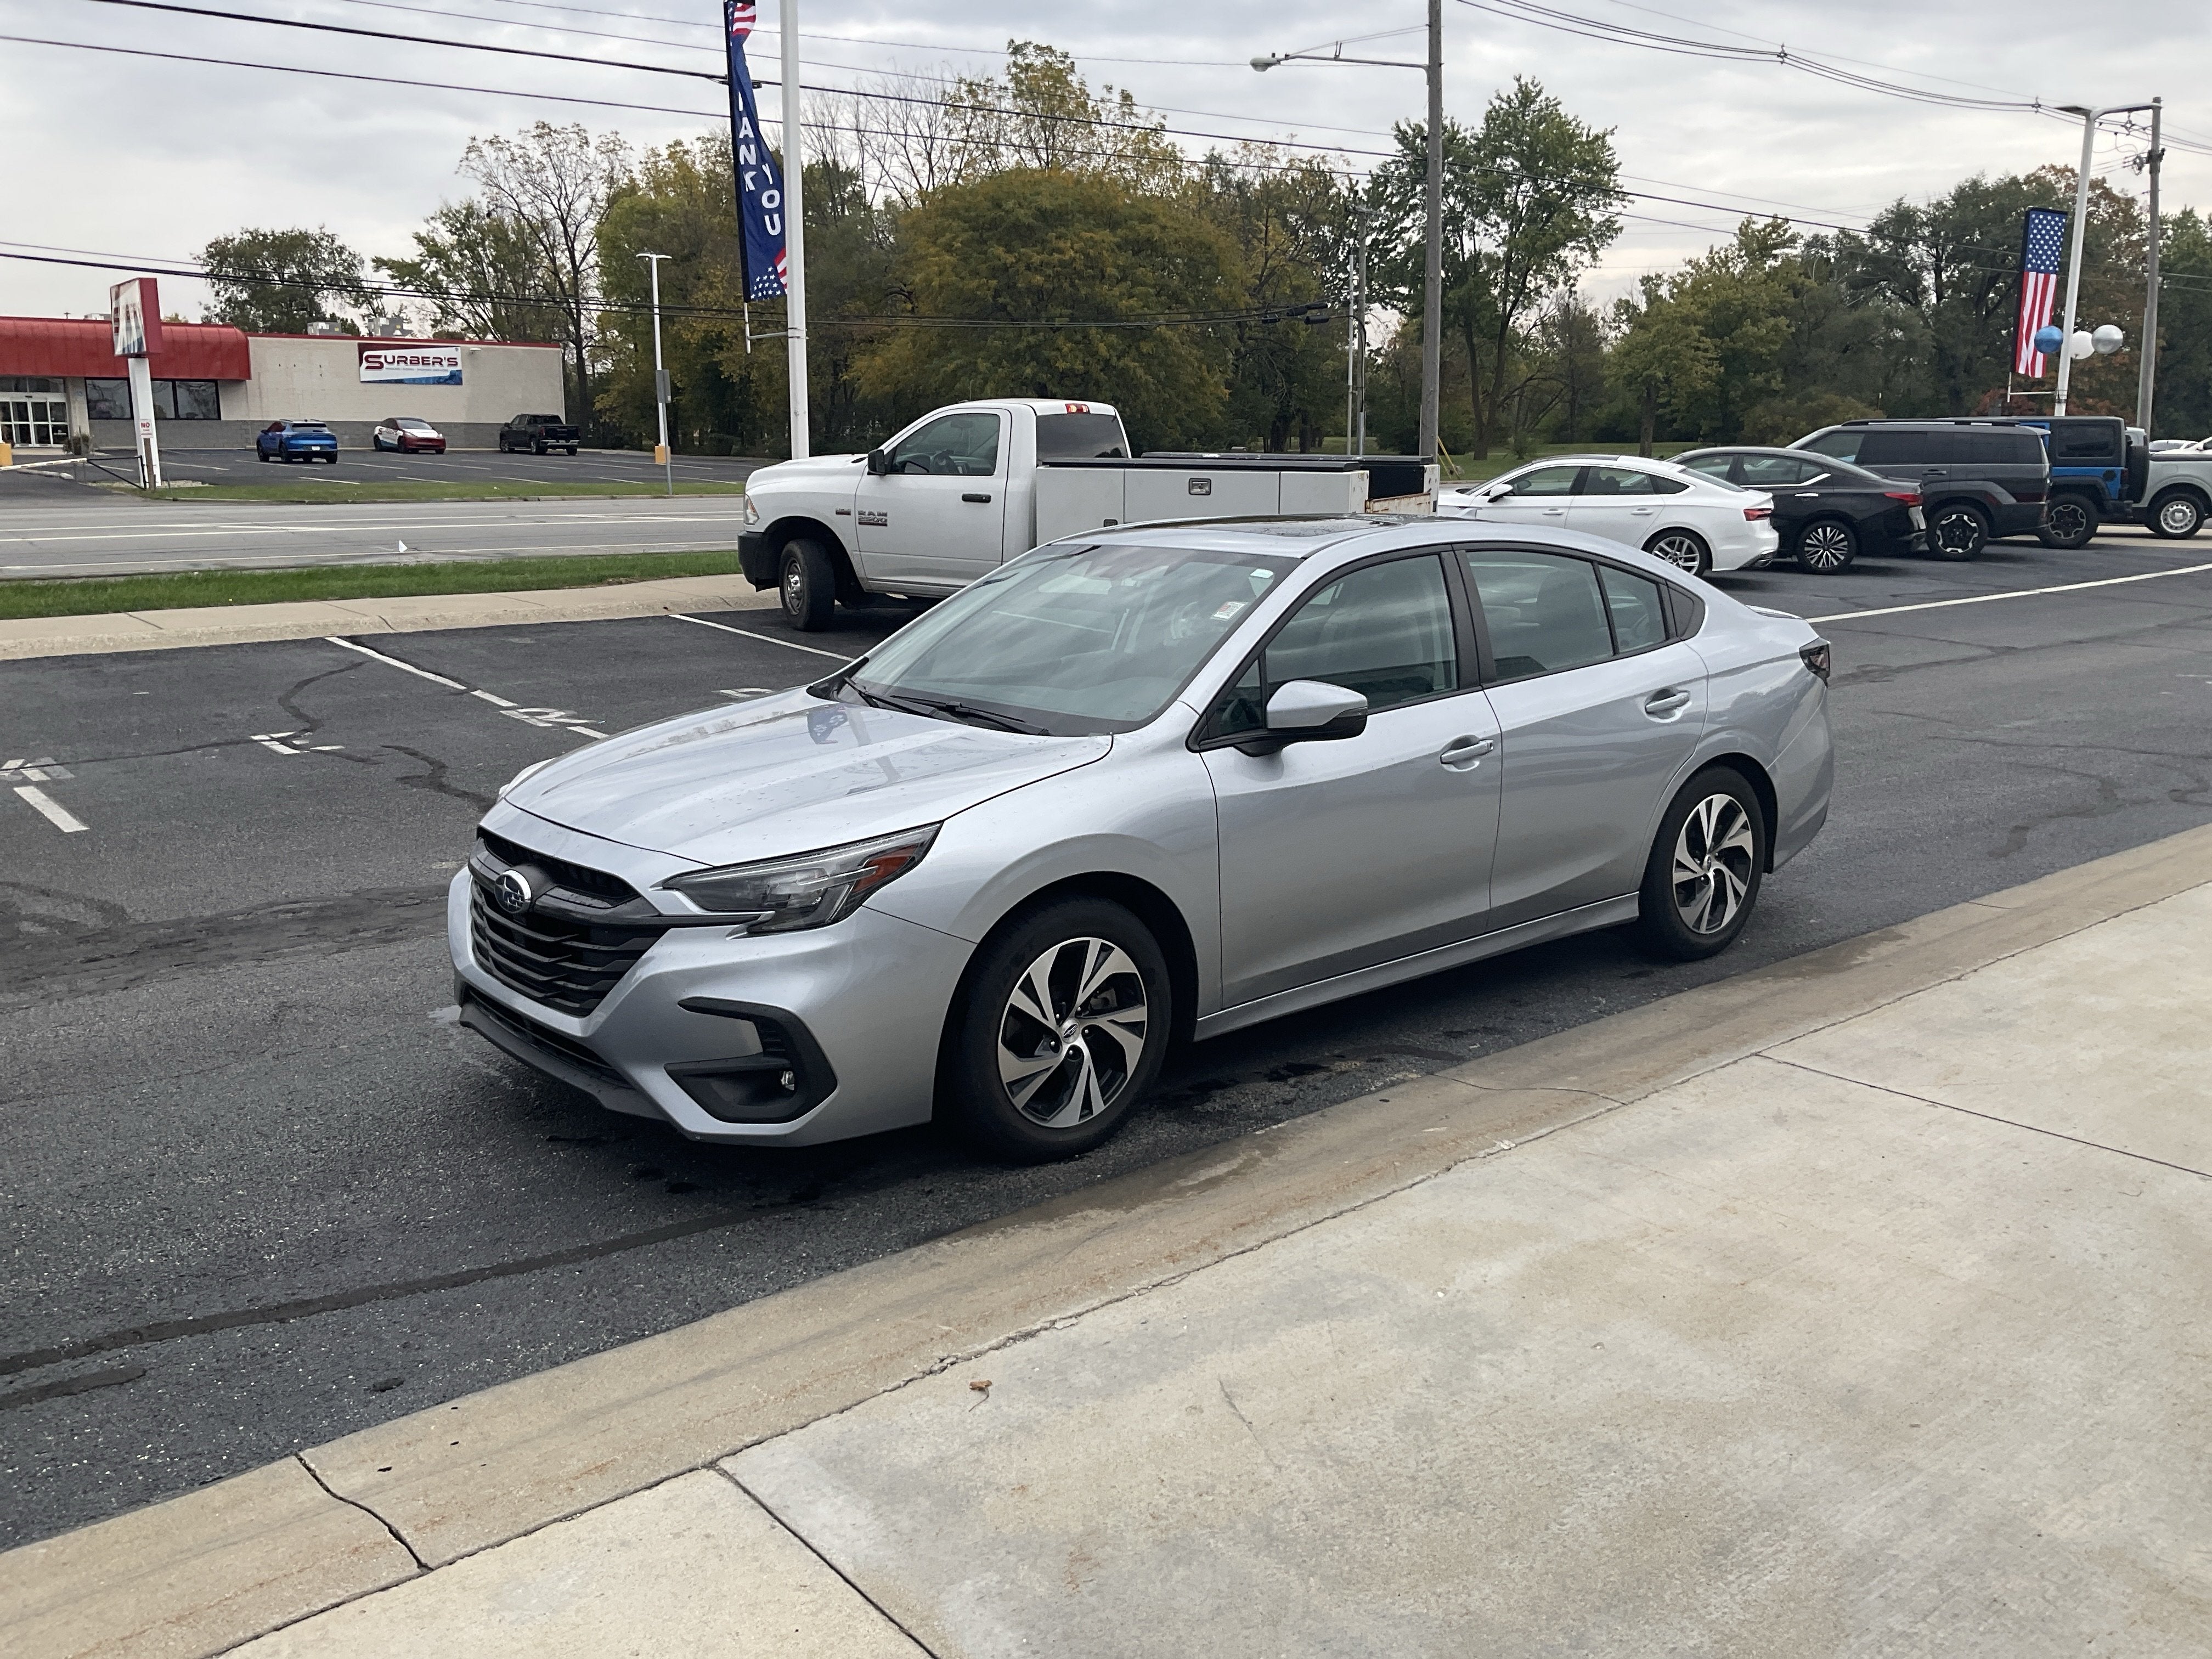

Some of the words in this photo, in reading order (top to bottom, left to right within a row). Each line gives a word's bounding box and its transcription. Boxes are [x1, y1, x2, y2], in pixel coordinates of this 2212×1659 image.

[738, 91, 758, 192] ANK
[761, 163, 781, 236] YOU
[364, 354, 459, 371] SURBER'S
